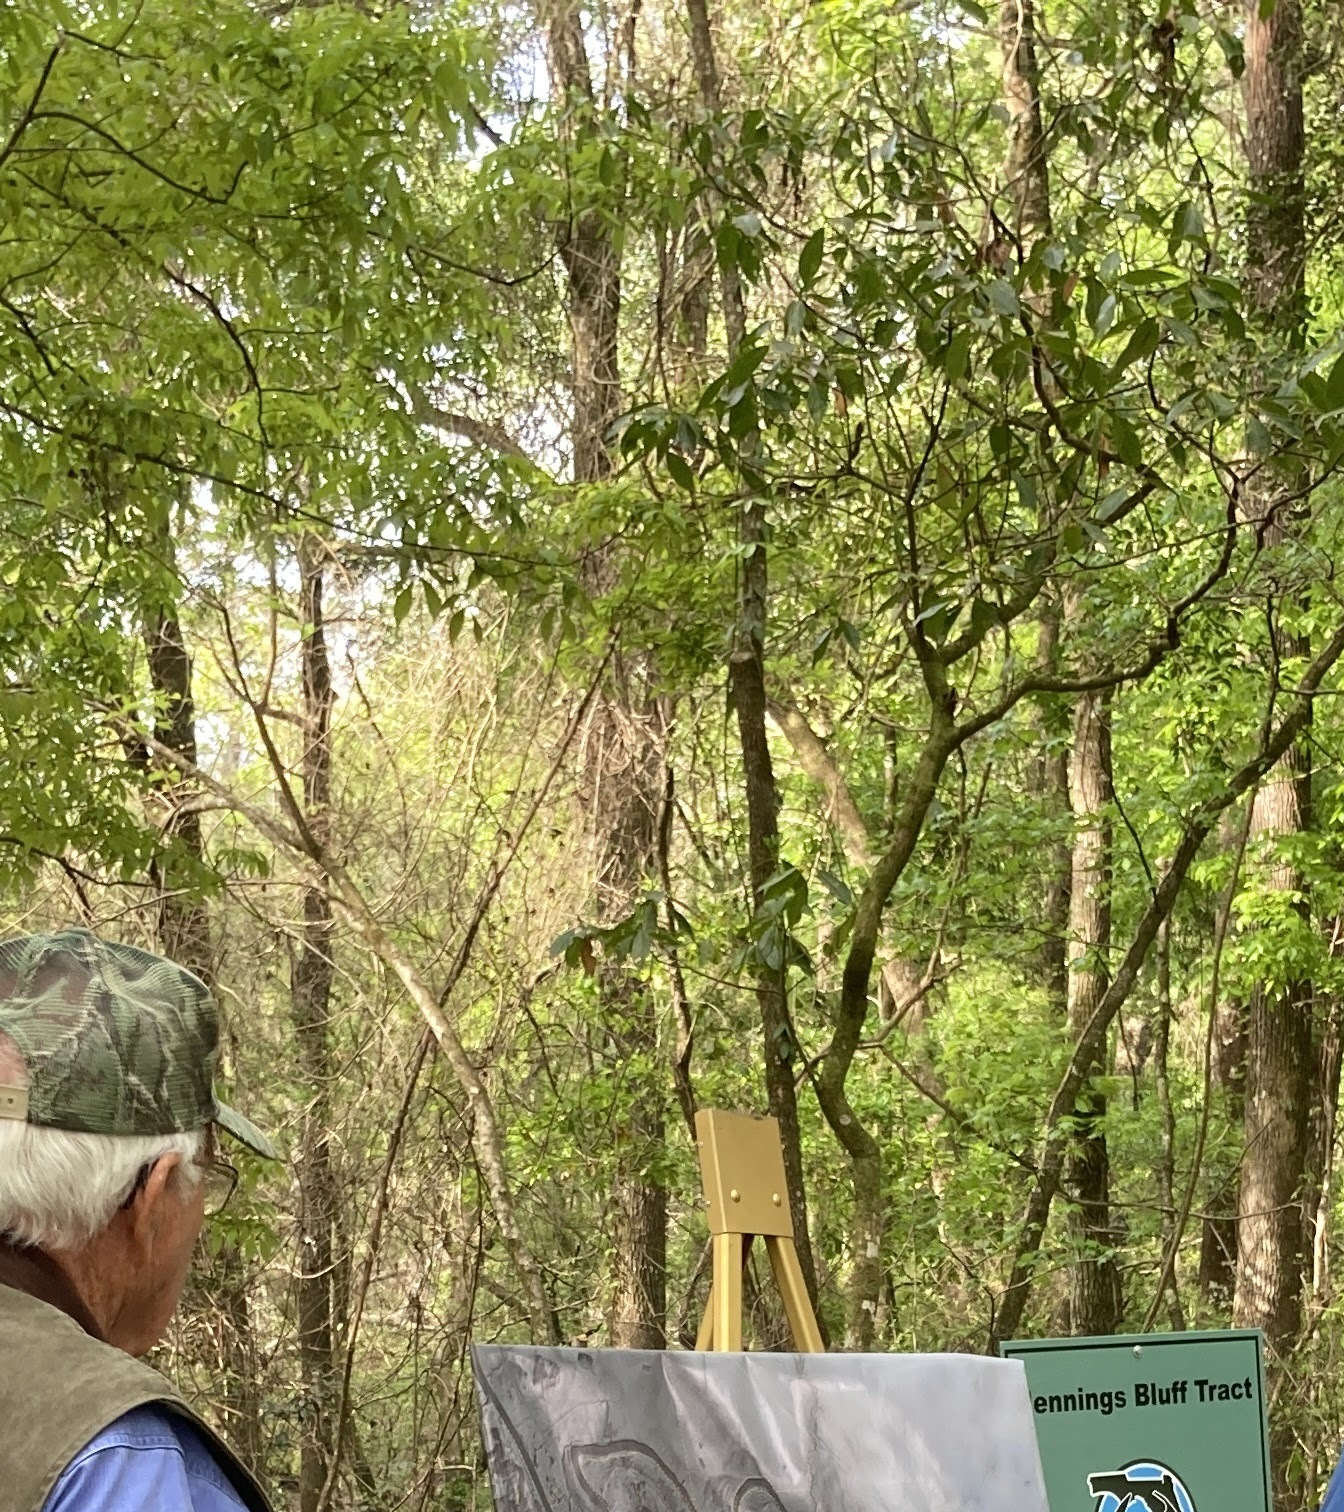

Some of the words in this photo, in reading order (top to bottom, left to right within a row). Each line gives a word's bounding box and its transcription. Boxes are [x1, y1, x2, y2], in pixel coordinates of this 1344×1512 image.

[1029, 1388, 1127, 1416] ennings
[1135, 1381, 1188, 1407] Bluff
[1194, 1377, 1253, 1403] Tract
